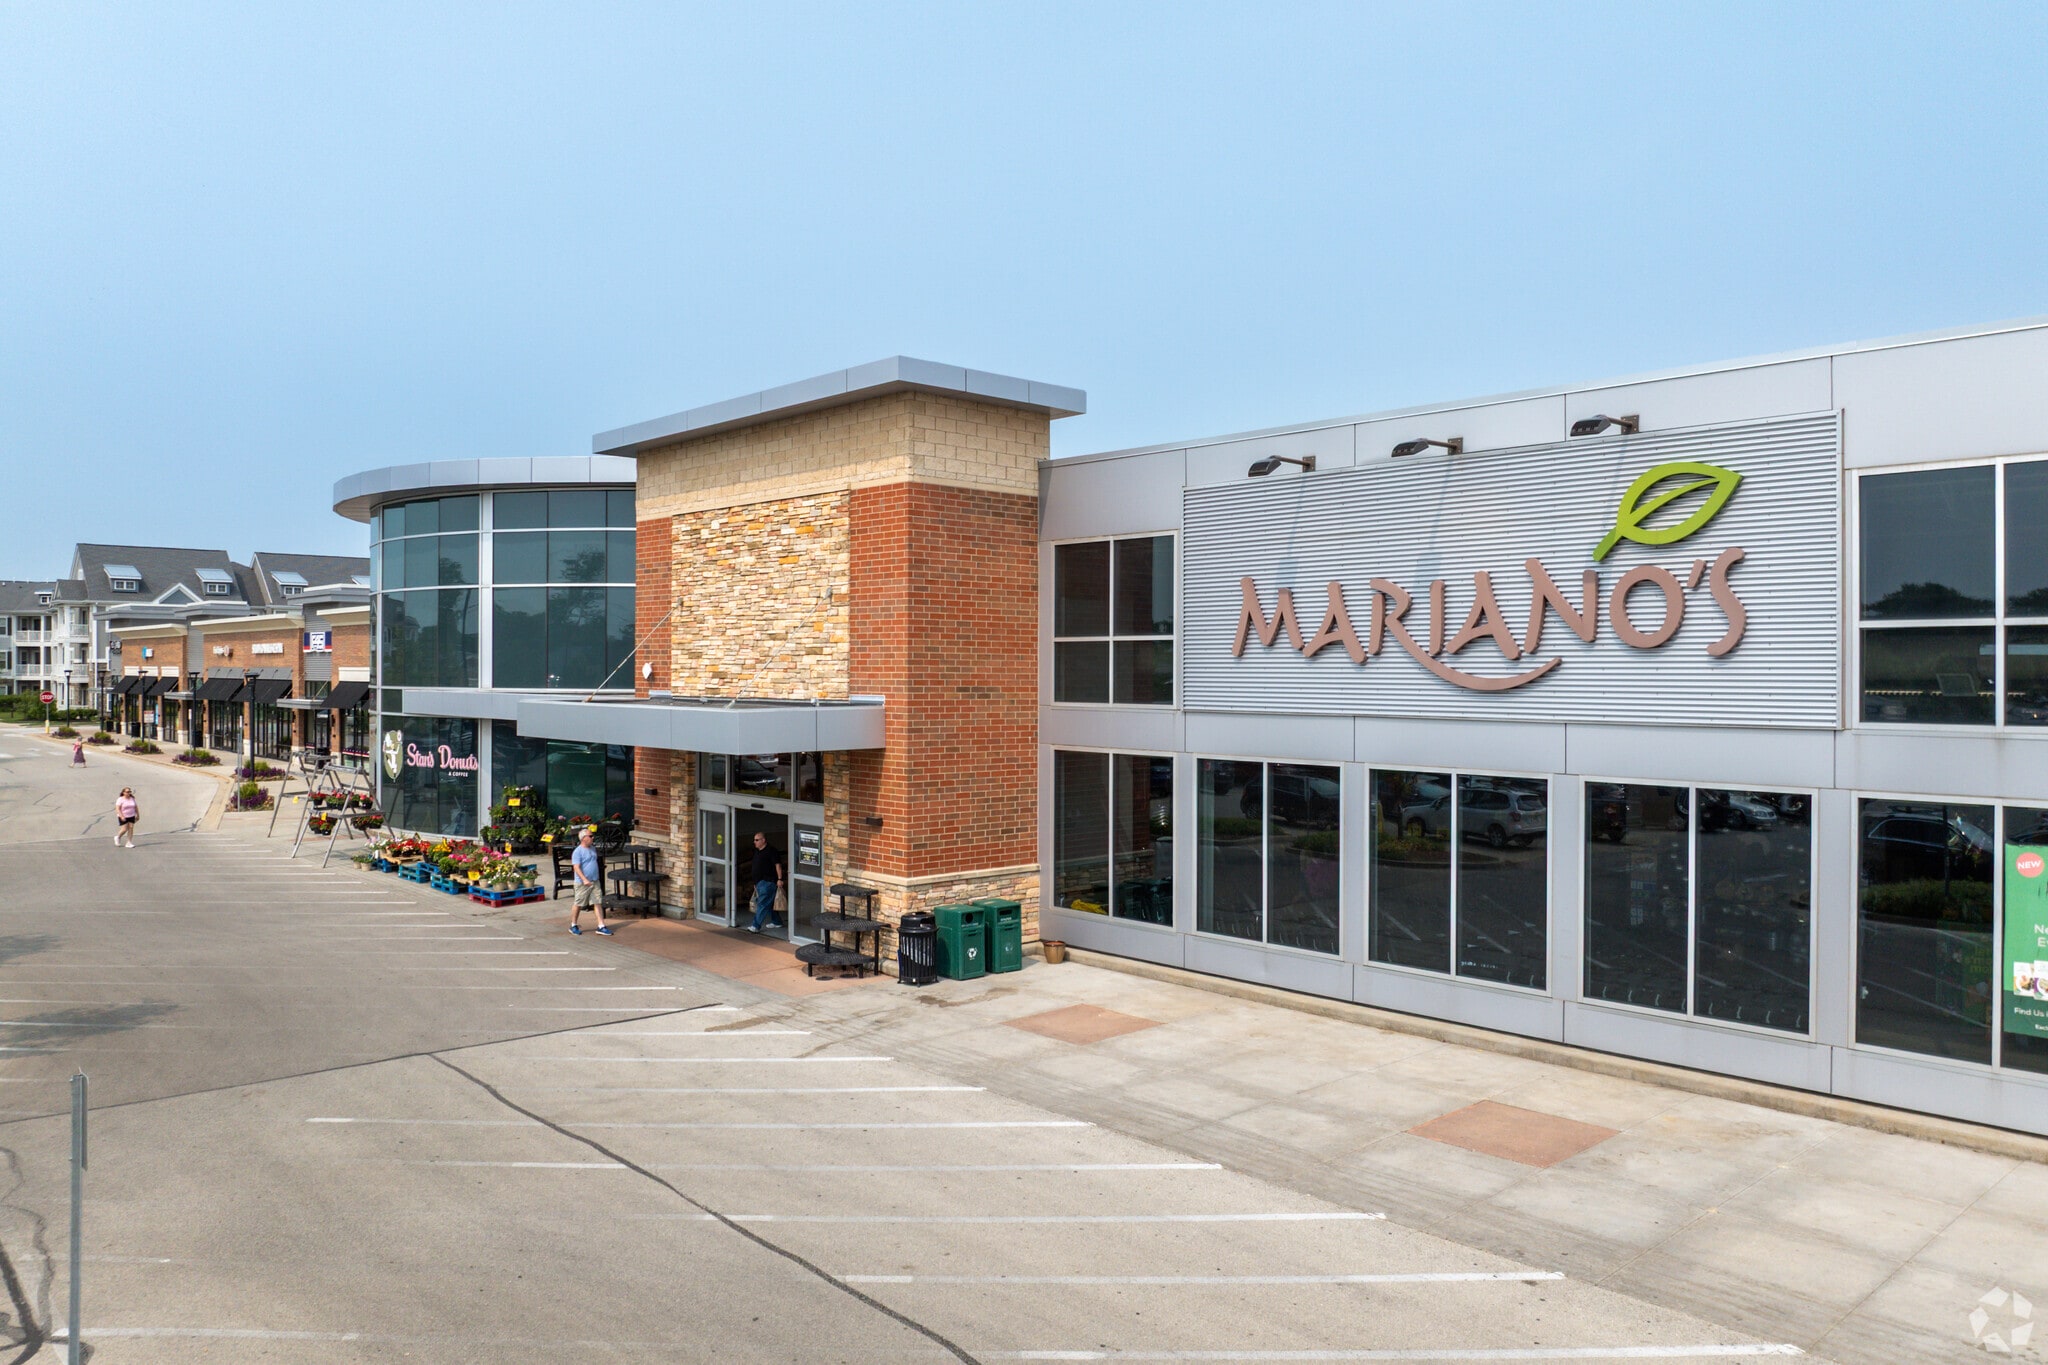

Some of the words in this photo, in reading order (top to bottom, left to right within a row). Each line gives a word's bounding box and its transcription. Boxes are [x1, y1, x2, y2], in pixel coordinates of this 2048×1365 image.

[1231, 547, 1748, 692] MARIANO'S
[406, 743, 434, 768] Stan's
[438, 744, 479, 771] Donuts
[2017, 860, 2042, 870] NEW
[2014, 1006, 2032, 1016] Find
[2033, 1009, 2045, 1018] Us
